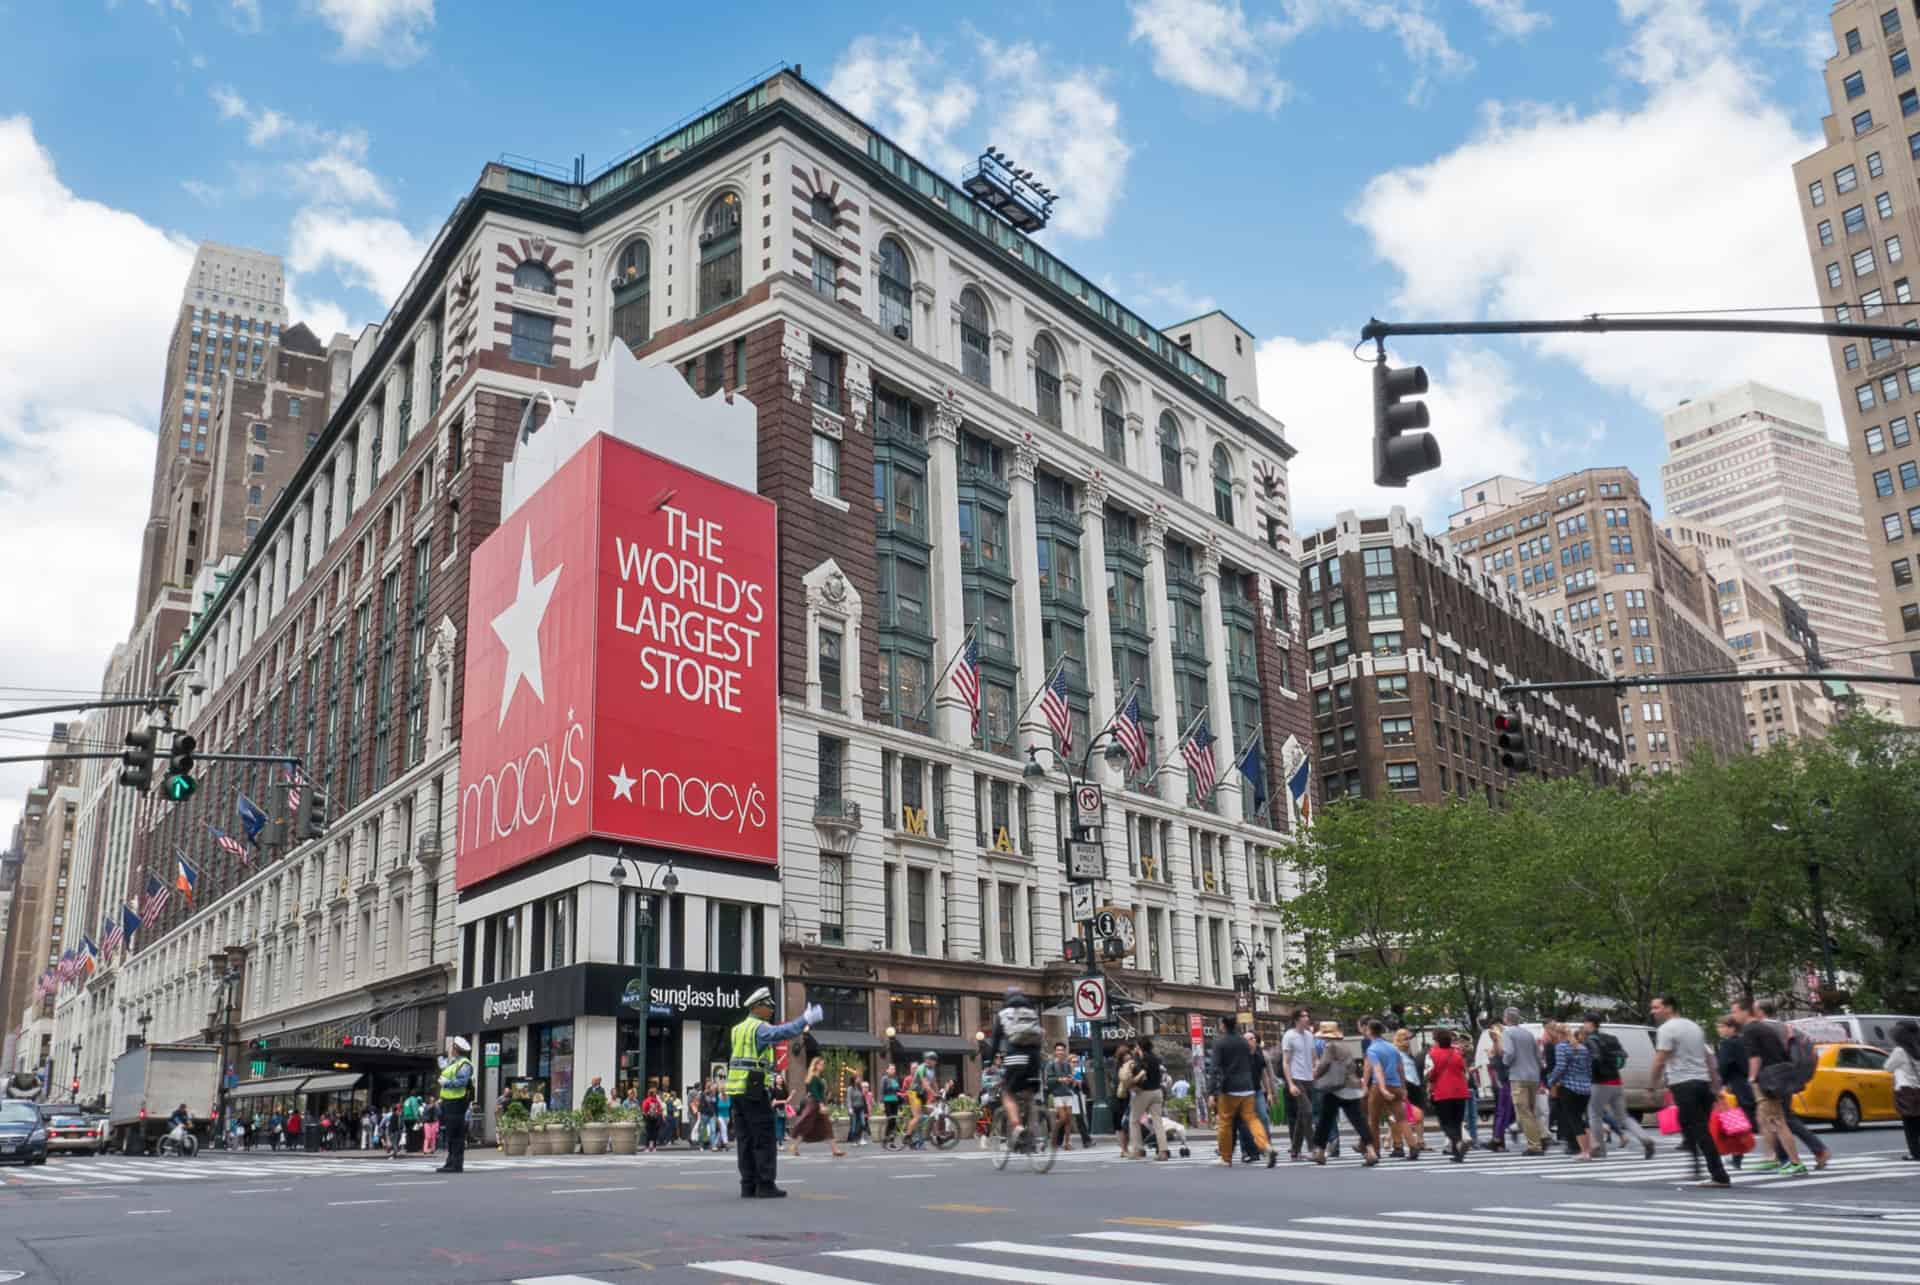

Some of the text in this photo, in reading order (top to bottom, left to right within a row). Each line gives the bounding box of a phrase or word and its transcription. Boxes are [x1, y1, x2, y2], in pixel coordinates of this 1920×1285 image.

[660, 504, 724, 564] THE
[615, 537, 763, 623] WORLD'S
[615, 587, 761, 667] LARGEST
[640, 646, 742, 713] STORE
[461, 706, 585, 856] macy's
[642, 767, 767, 834] macy's
[650, 984, 714, 1012] sunglass
[717, 986, 741, 1009] hut
